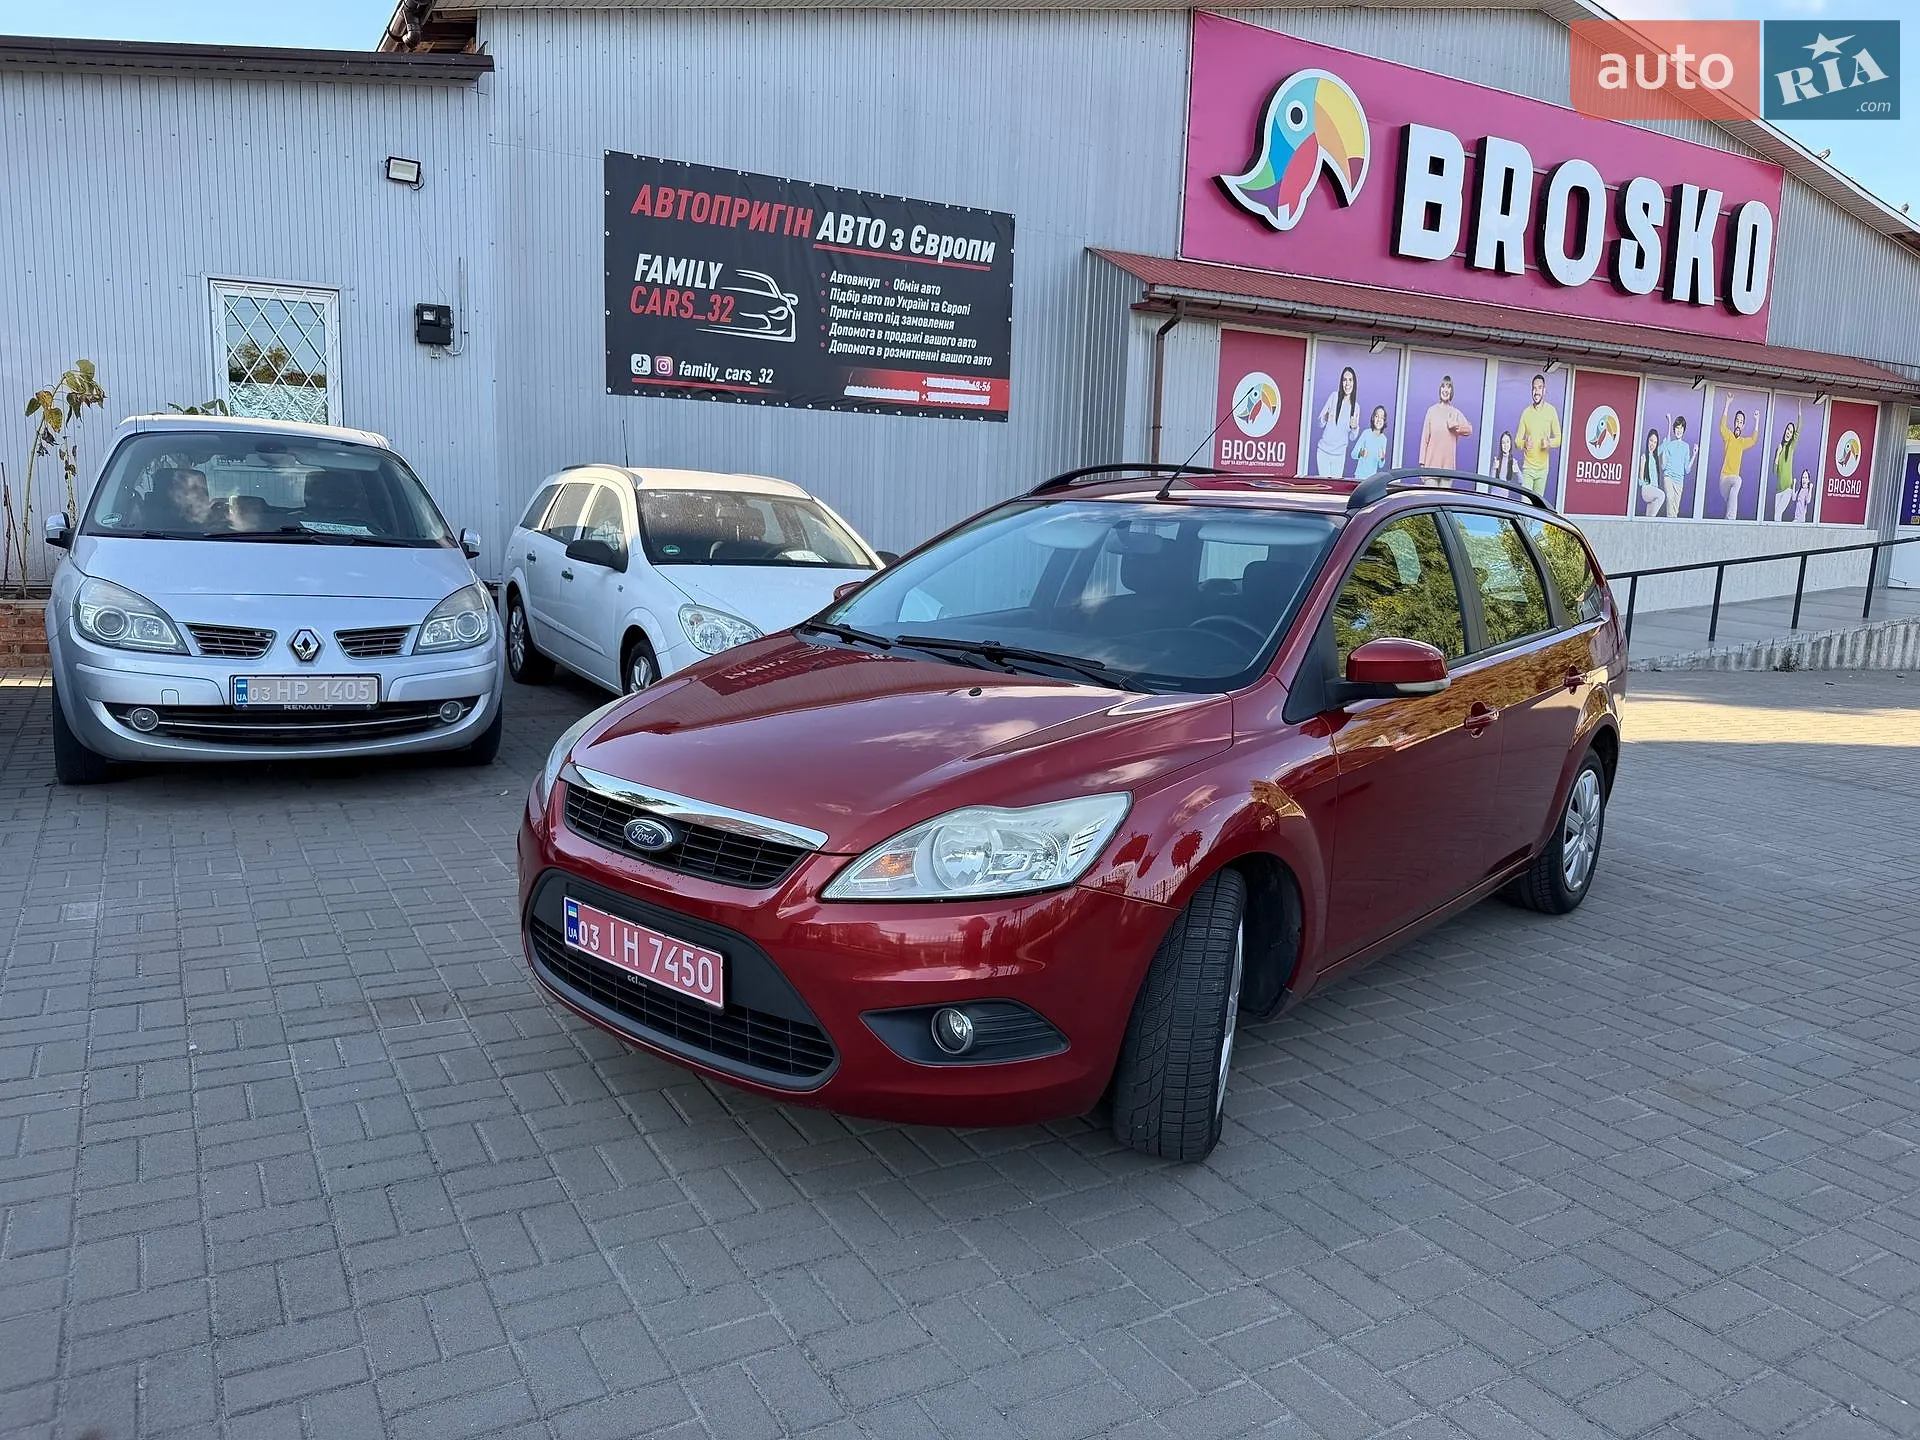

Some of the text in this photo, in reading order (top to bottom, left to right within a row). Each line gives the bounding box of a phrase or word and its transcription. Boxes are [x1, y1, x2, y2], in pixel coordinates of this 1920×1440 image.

[630, 184, 814, 238] АВТОПРИГІН
[1391, 122, 1773, 315] BROSKO
[815, 212, 997, 264] АВТО з Європи
[634, 253, 723, 290] FAMILY
[830, 270, 880, 290] Автовикуп
[893, 278, 941, 296] Обмін авто
[630, 285, 735, 323] CARS_32
[830, 288, 971, 316] Підбір авто по Україні та Європі
[829, 305, 955, 330] Пригін авто під замовлення
[829, 322, 977, 349] Допомога в продажі вашого авто
[829, 340, 993, 366] Допомога в розмитненні вашого авто
[678, 360, 774, 385] family_cars_32
[1221, 439, 1286, 462] BROSKO
[1576, 461, 1622, 480] BROSKO
[1828, 478, 1862, 495] BROSKO
[236, 681, 370, 701] UA 03 HP 1405
[631, 824, 657, 845] Ford
[568, 926, 578, 941] UA
[578, 921, 600, 951] 03
[649, 937, 714, 994] 7450
